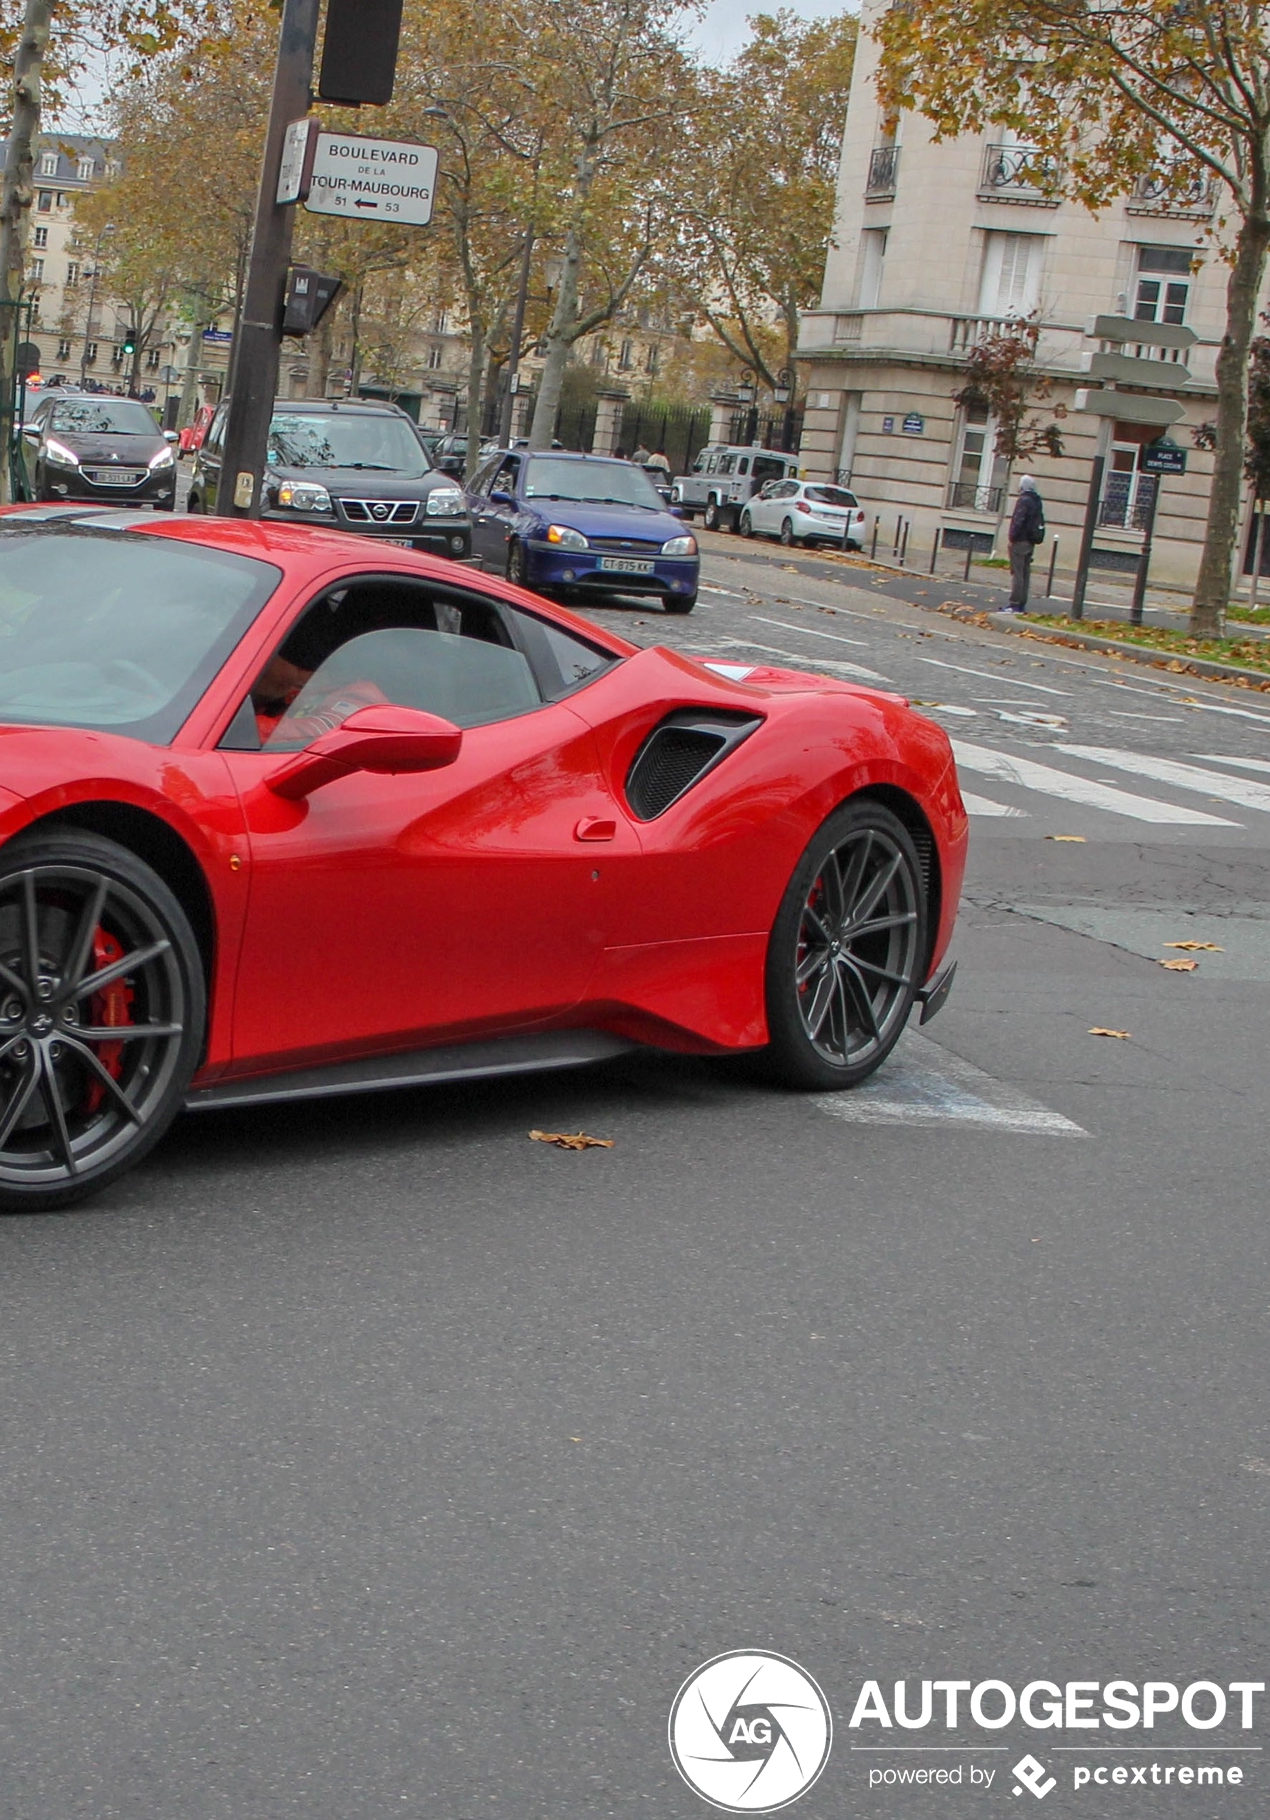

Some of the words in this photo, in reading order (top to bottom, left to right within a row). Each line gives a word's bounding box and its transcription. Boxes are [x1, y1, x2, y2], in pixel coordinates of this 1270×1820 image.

[329, 145, 419, 165] BOULEVARD
[358, 166, 370, 175] DE
[374, 167, 386, 176] LA
[312, 175, 429, 200] TOUR-MAUBOURG
[334, 196, 347, 206] 51
[385, 202, 400, 213] 53
[1157, 452, 1173, 460] PLACE
